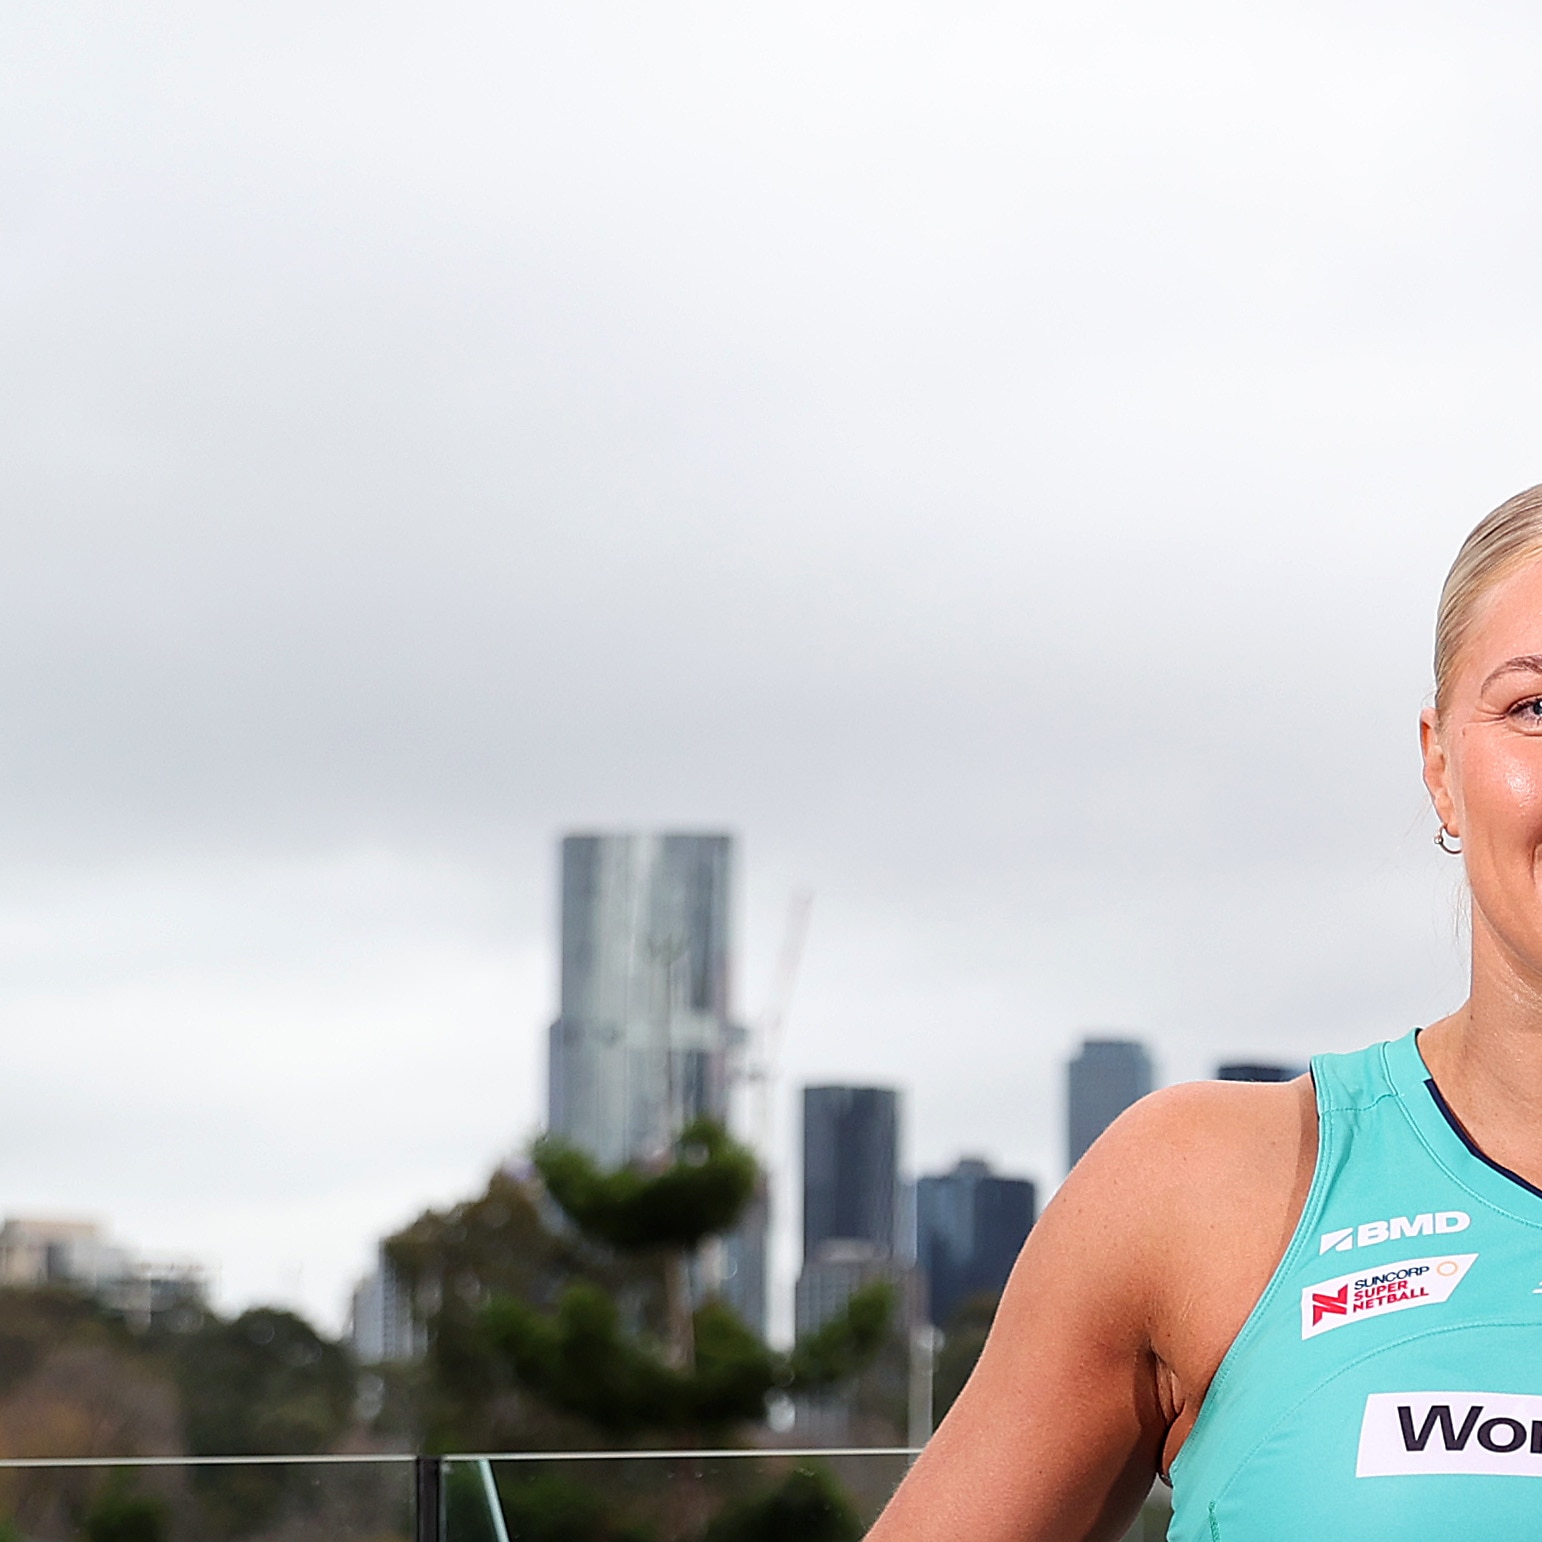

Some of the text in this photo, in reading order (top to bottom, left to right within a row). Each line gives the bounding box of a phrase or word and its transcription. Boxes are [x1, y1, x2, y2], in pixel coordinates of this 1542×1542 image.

[1357, 1211, 1471, 1247] BMD
[1354, 1266, 1430, 1290] SUNCORP
[1354, 1280, 1408, 1301] SUPER
[1353, 1287, 1429, 1313] NETBALL
